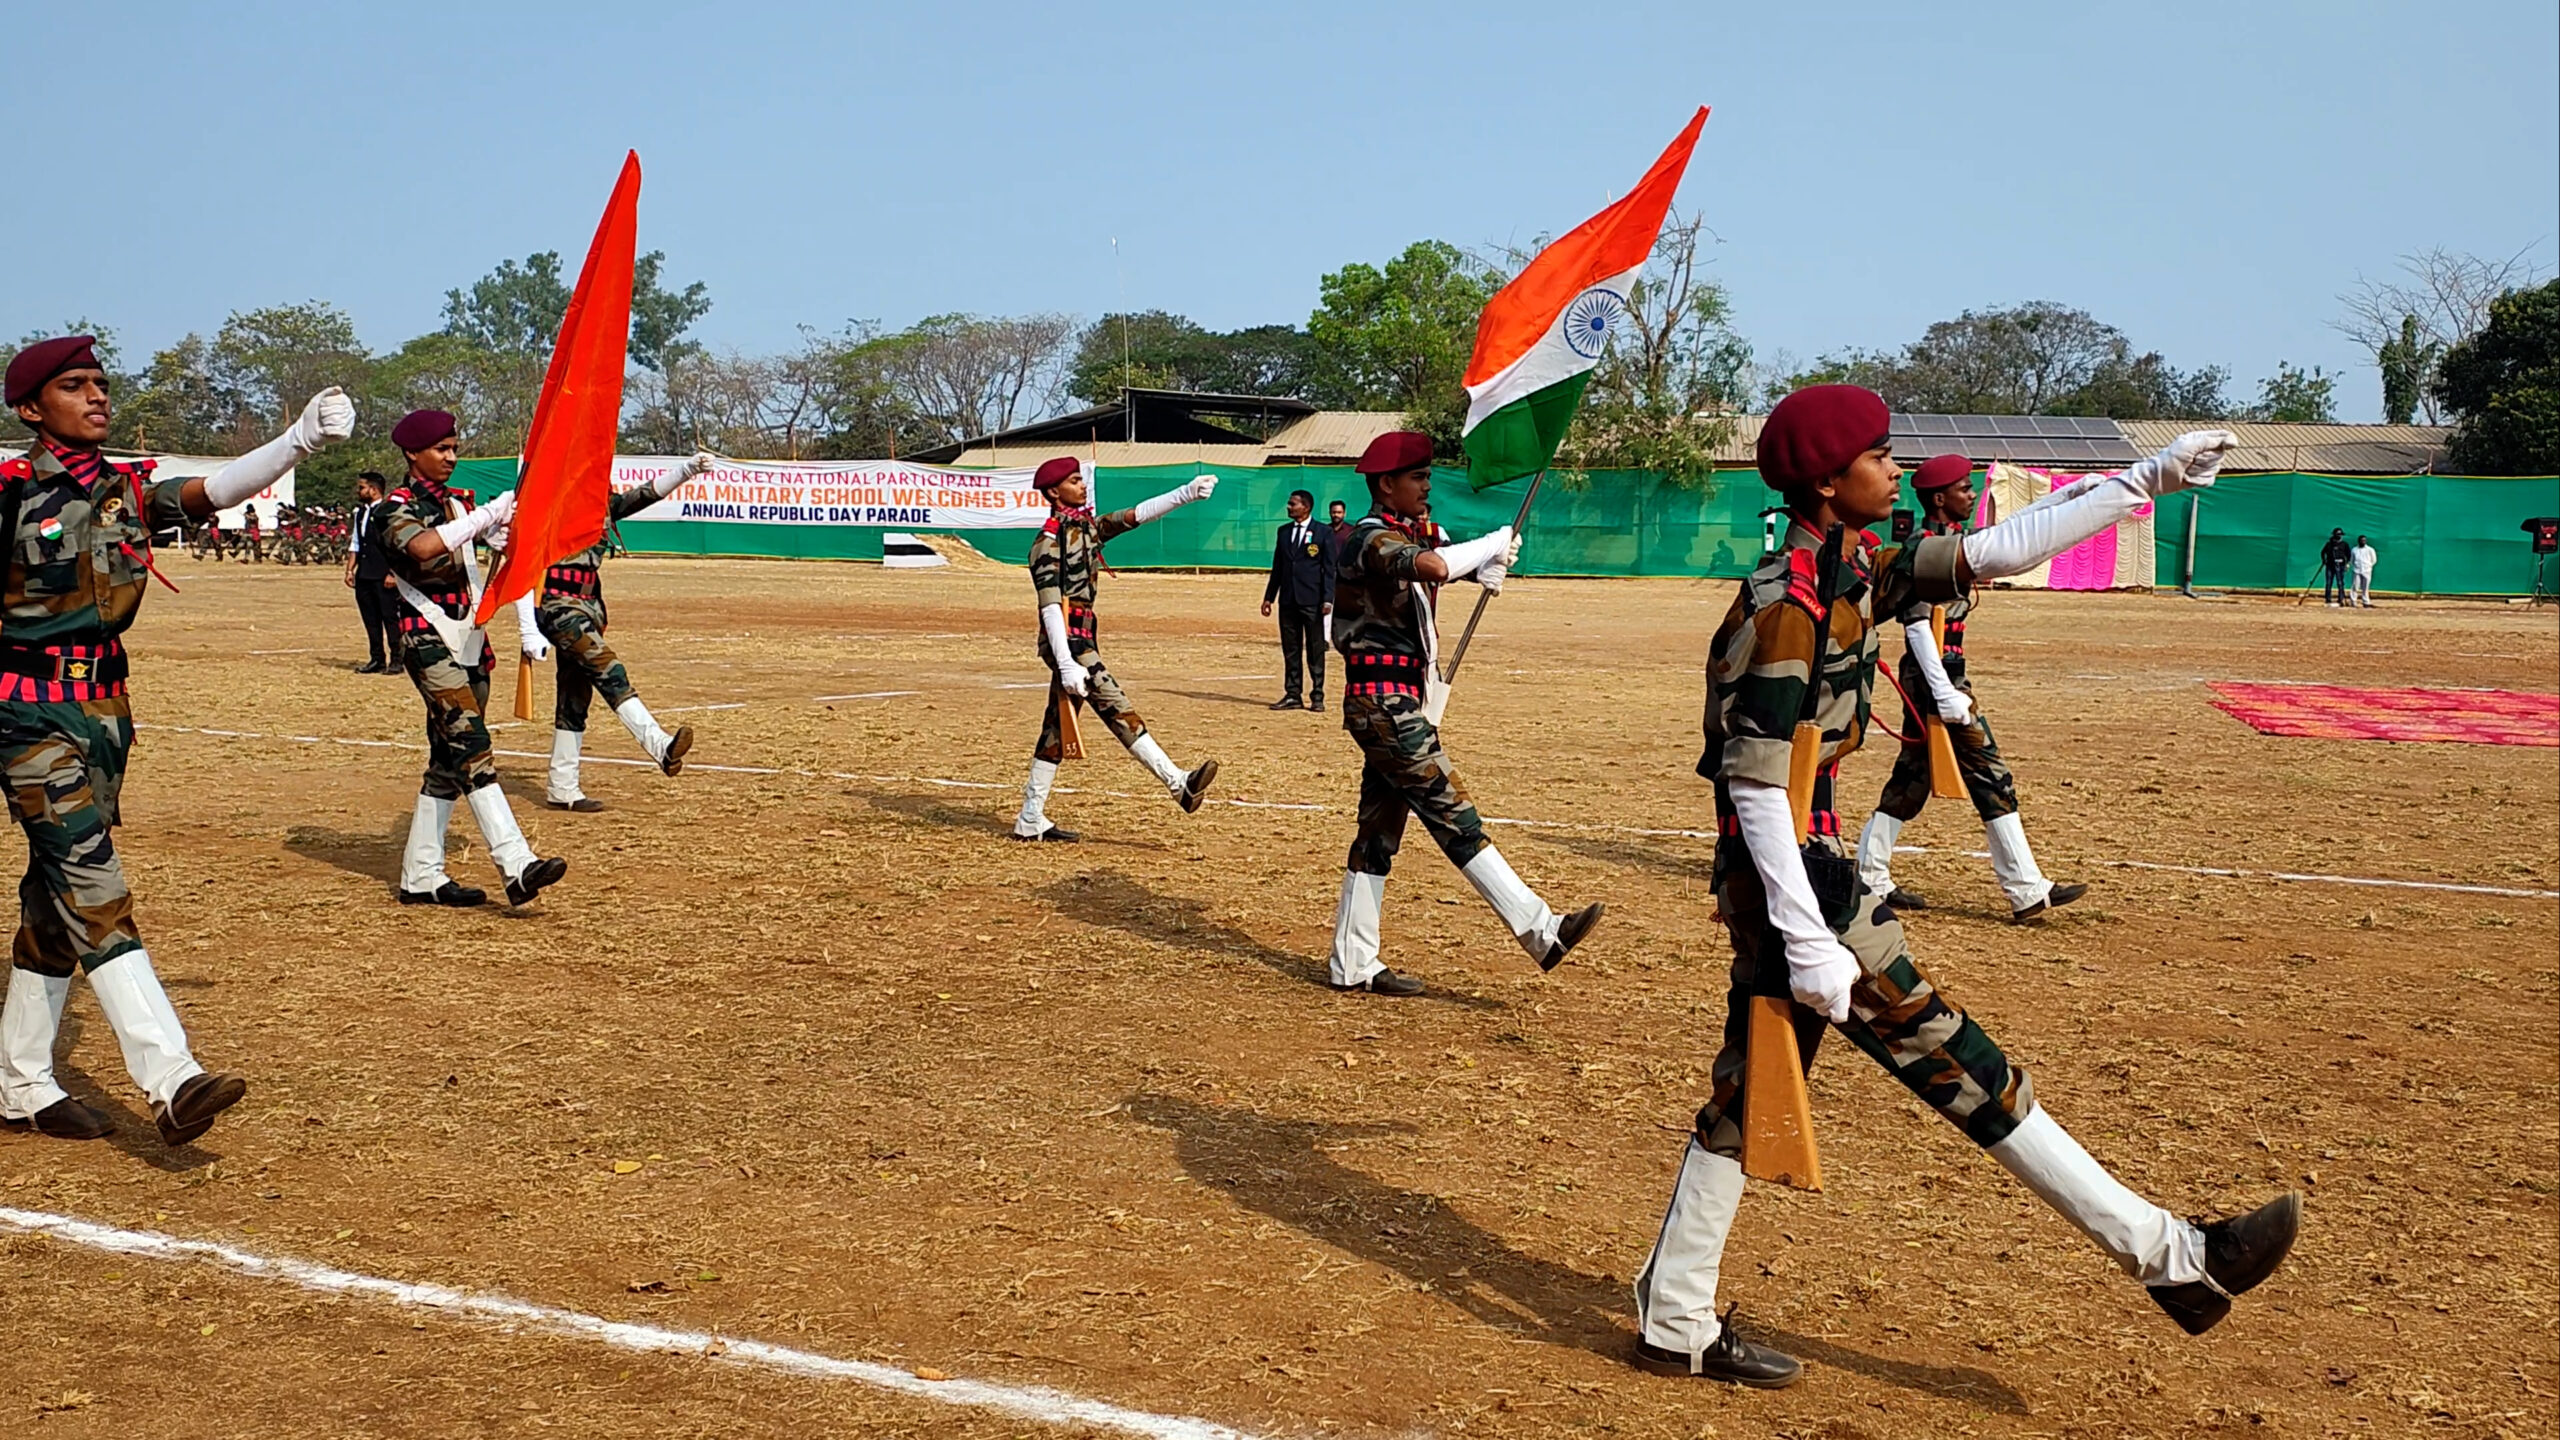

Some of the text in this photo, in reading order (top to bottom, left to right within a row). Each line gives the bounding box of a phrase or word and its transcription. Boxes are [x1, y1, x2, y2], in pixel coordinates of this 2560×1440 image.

[704, 470, 775, 484] HOCKEY
[781, 472, 871, 485] NATIONAL
[877, 472, 992, 488] PARTICIPANT
[715, 484, 804, 505] MILITARY
[811, 487, 887, 506] SCHOOL
[893, 488, 1006, 508] WELCOMES
[681, 503, 931, 523] ANNUAL REPUBLIC DAY PARADE
